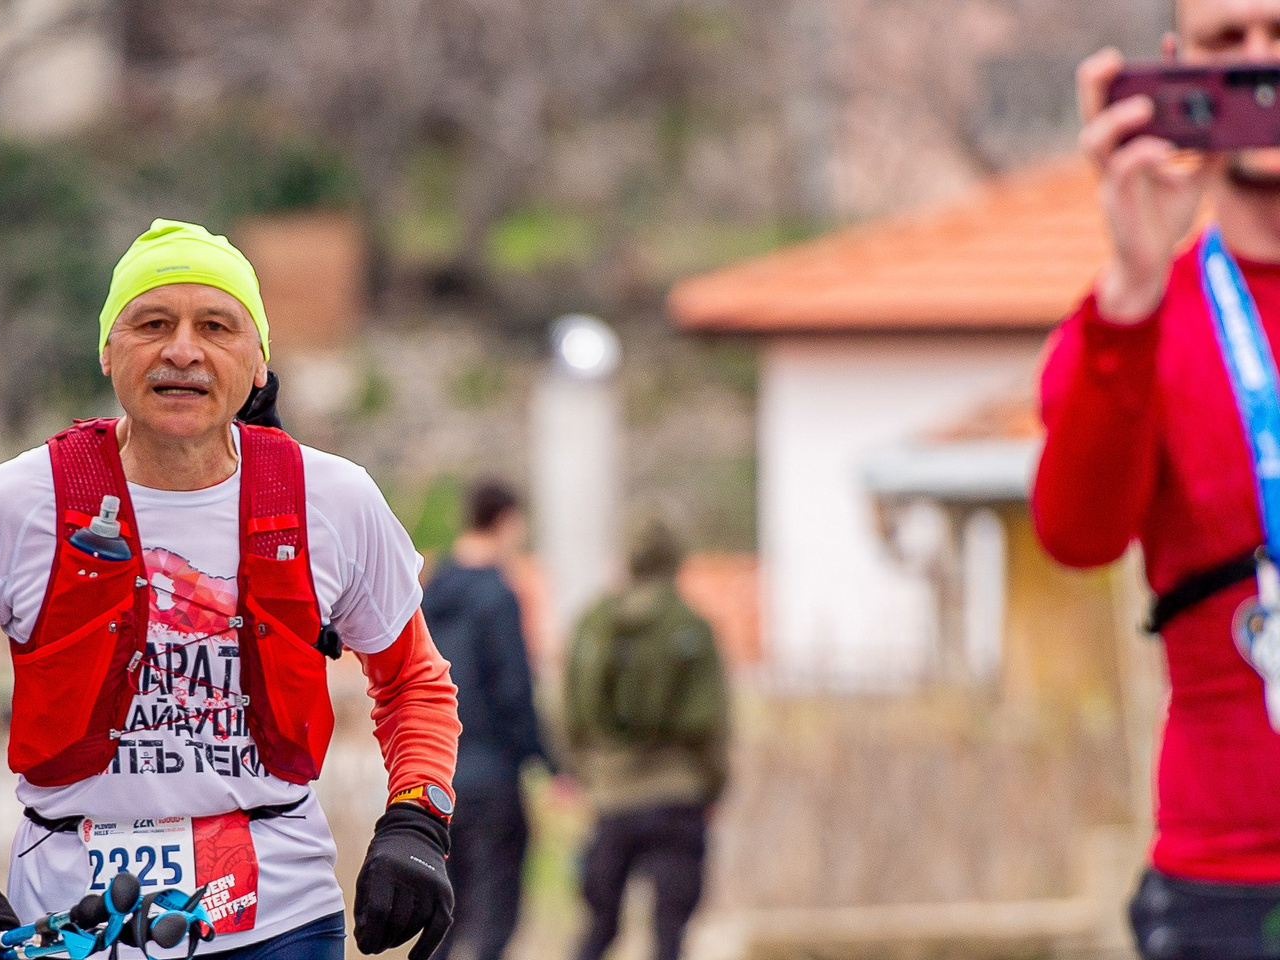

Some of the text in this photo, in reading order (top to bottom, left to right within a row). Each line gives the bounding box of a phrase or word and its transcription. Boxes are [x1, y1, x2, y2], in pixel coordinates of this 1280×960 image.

[134, 642, 240, 699] АРАТ
[88, 844, 183, 890] 2325
[207, 891, 258, 922] ATTERS
